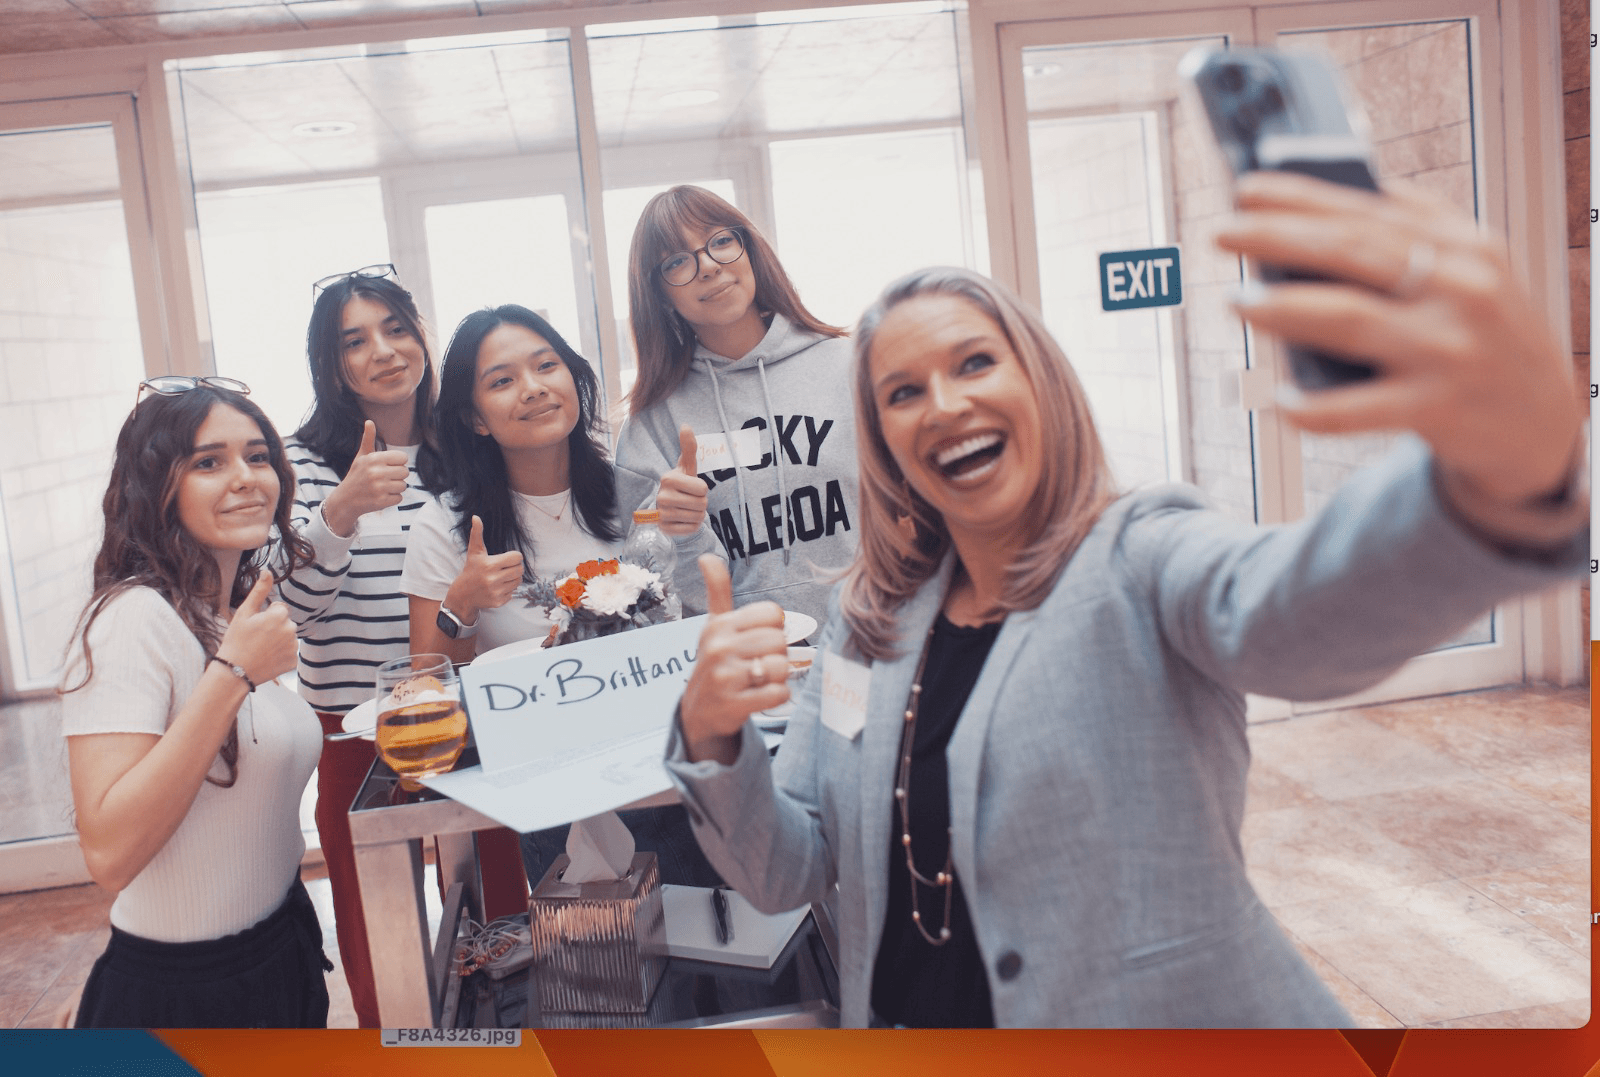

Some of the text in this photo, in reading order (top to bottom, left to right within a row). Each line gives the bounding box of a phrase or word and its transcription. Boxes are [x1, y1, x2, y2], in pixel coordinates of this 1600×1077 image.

[1106, 257, 1174, 301] EXIT
[697, 415, 835, 490] CKY
[480, 683, 546, 711] Dr.
[385, 1028, 516, 1045] _F8A4326.jpg
